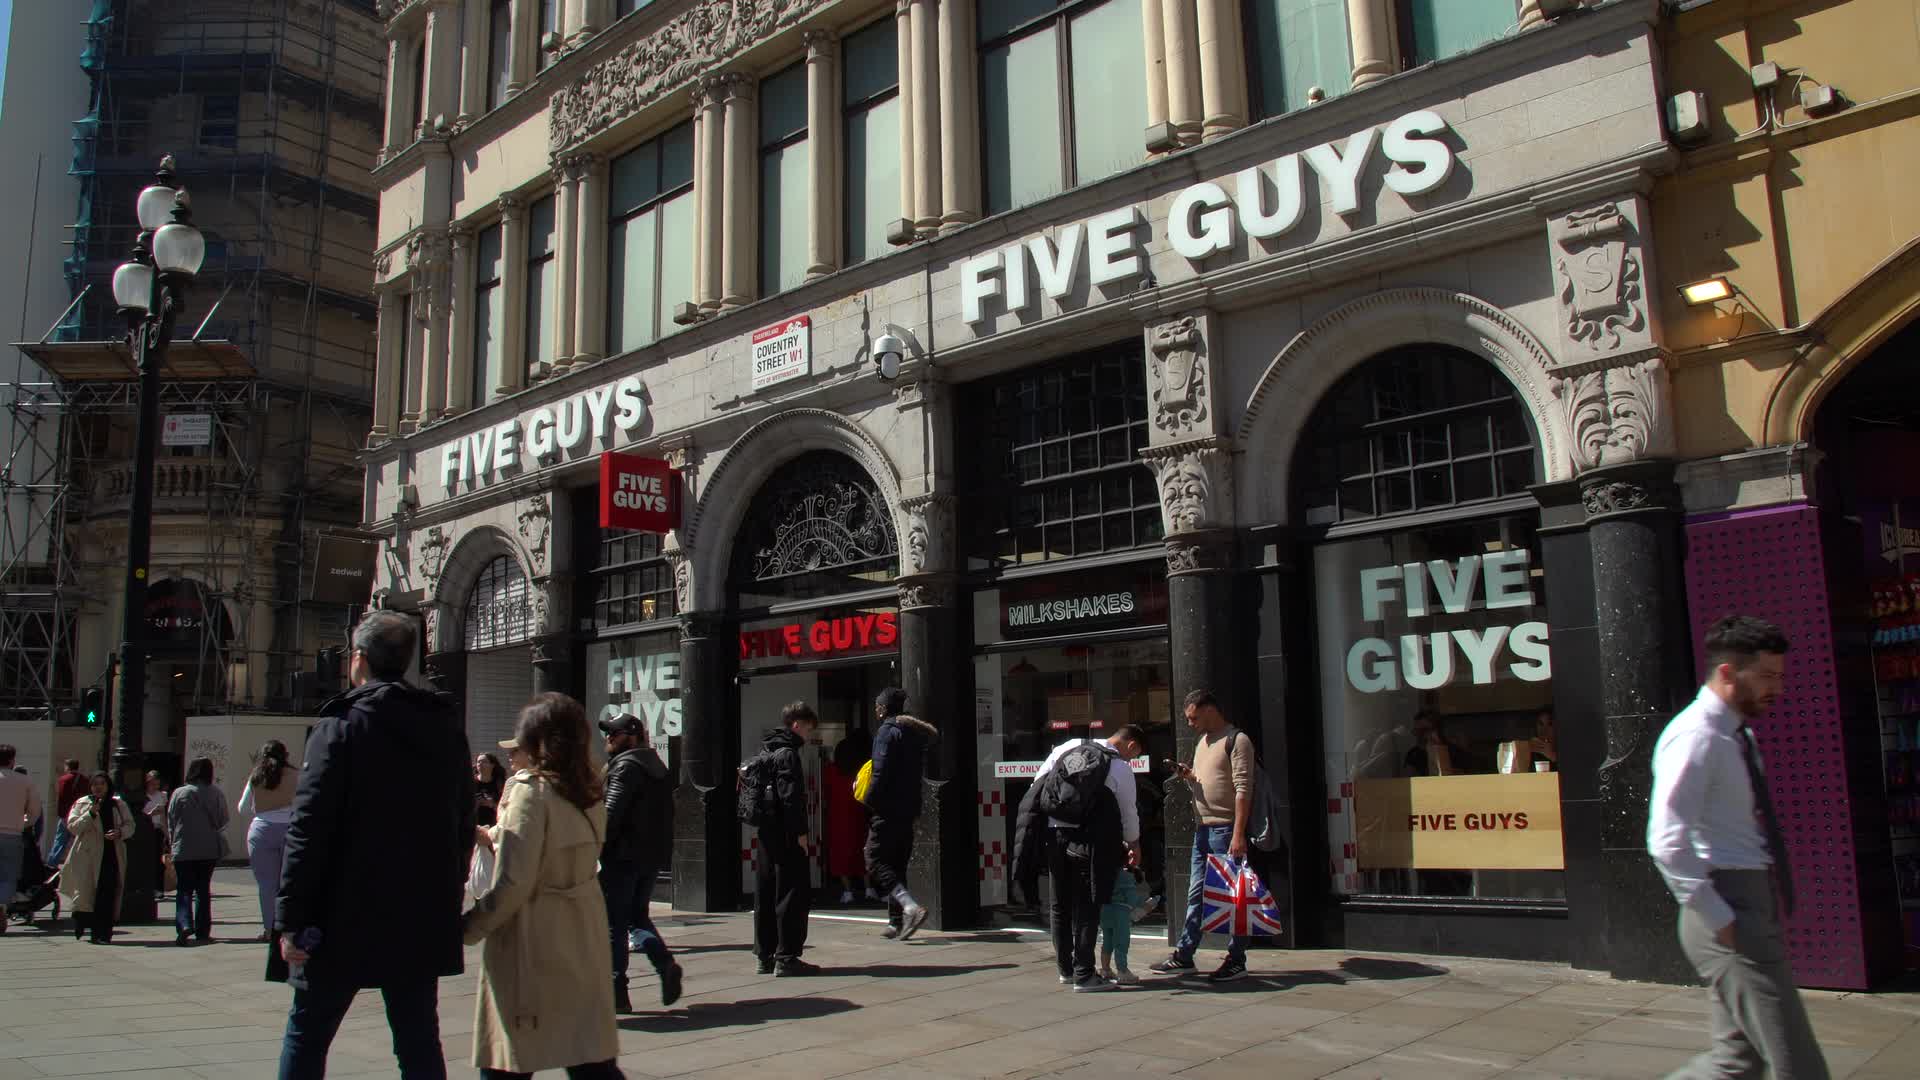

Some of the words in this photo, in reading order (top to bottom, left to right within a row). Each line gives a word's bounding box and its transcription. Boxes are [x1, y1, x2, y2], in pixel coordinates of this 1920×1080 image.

[960, 206, 1144, 325] FIVE
[1167, 109, 1455, 261] GUYS
[757, 335, 799, 359] COVENTRY
[757, 353, 787, 373] STREET
[790, 348, 802, 362] W1
[440, 417, 521, 487] FIVE
[527, 376, 646, 457] GUYS
[619, 472, 662, 494] FIVE
[613, 490, 667, 512] GUYS
[330, 568, 362, 576] zedwell
[1360, 548, 1536, 622] FIVE
[1008, 592, 1134, 626] MILKSHAKES
[809, 611, 897, 652] GUYS
[1347, 621, 1552, 693] GUYS
[607, 652, 680, 694] FIVE
[998, 765, 1017, 774] EXIT
[1019, 764, 1041, 773] ONLY
[1408, 814, 1456, 831] FIVE
[1464, 812, 1529, 830] GUYS
